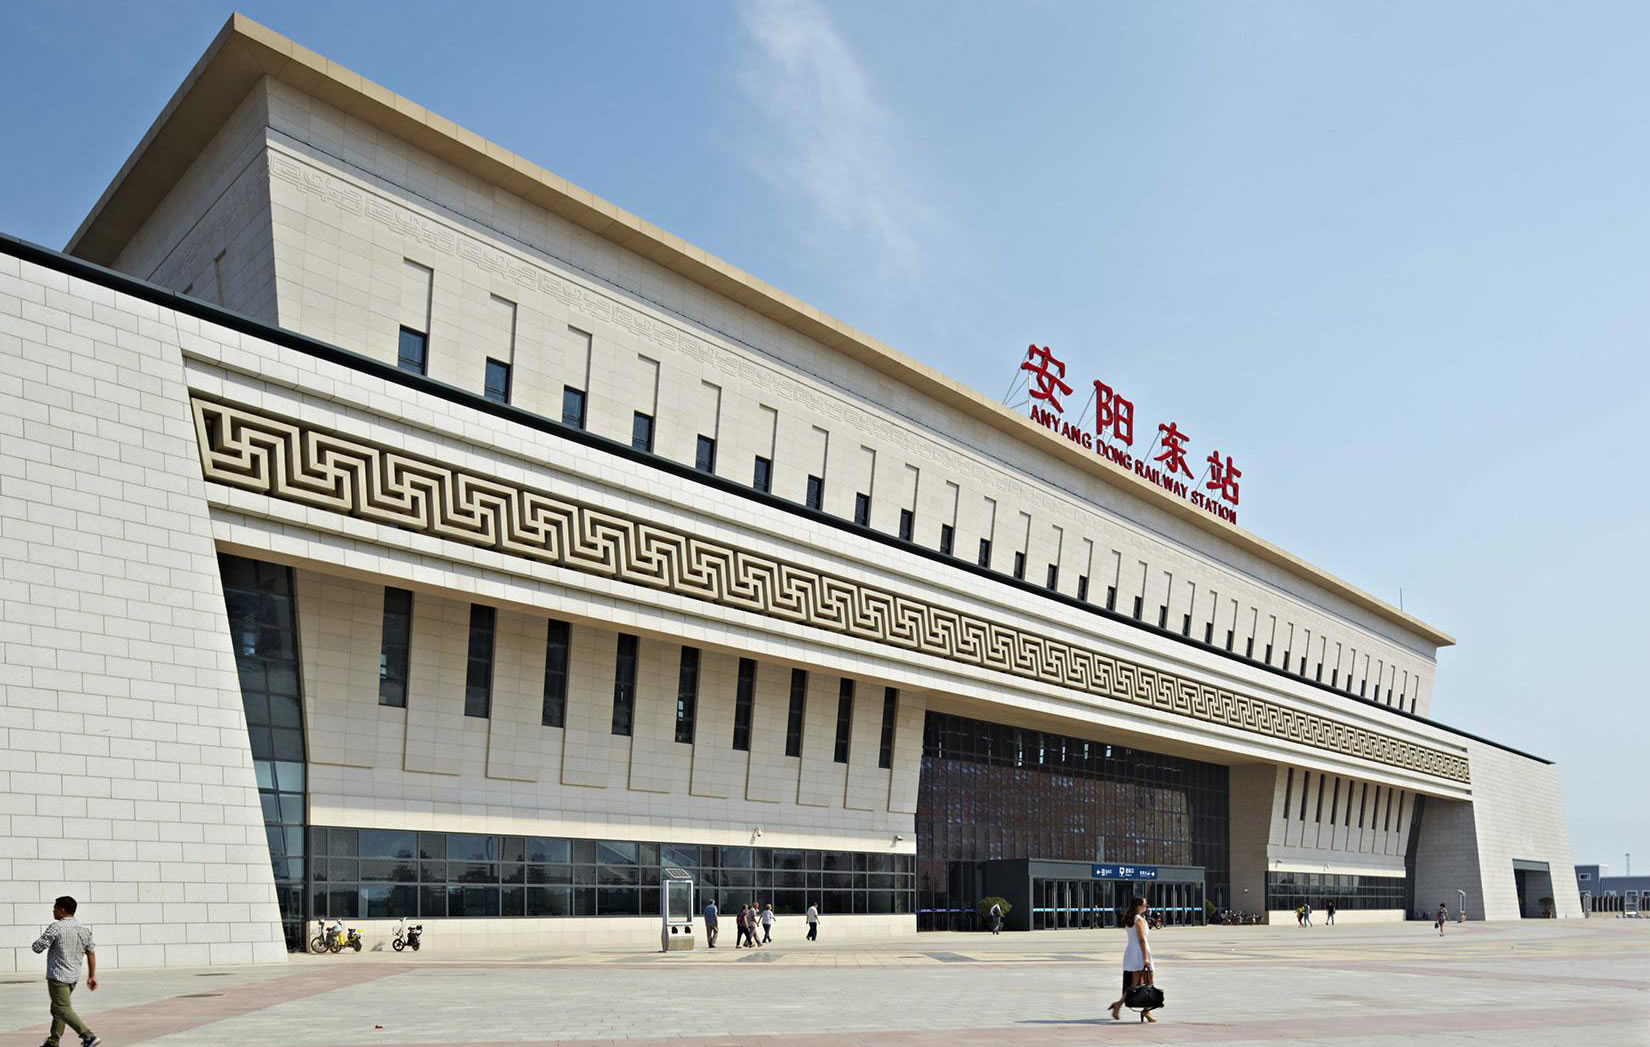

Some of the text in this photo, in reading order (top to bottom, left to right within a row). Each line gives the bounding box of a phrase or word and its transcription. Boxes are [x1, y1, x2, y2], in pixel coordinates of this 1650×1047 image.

[1021, 344, 1242, 505] 安阳东站
[1030, 404, 1237, 524] ANYANG DONG RAILWAY STATION
